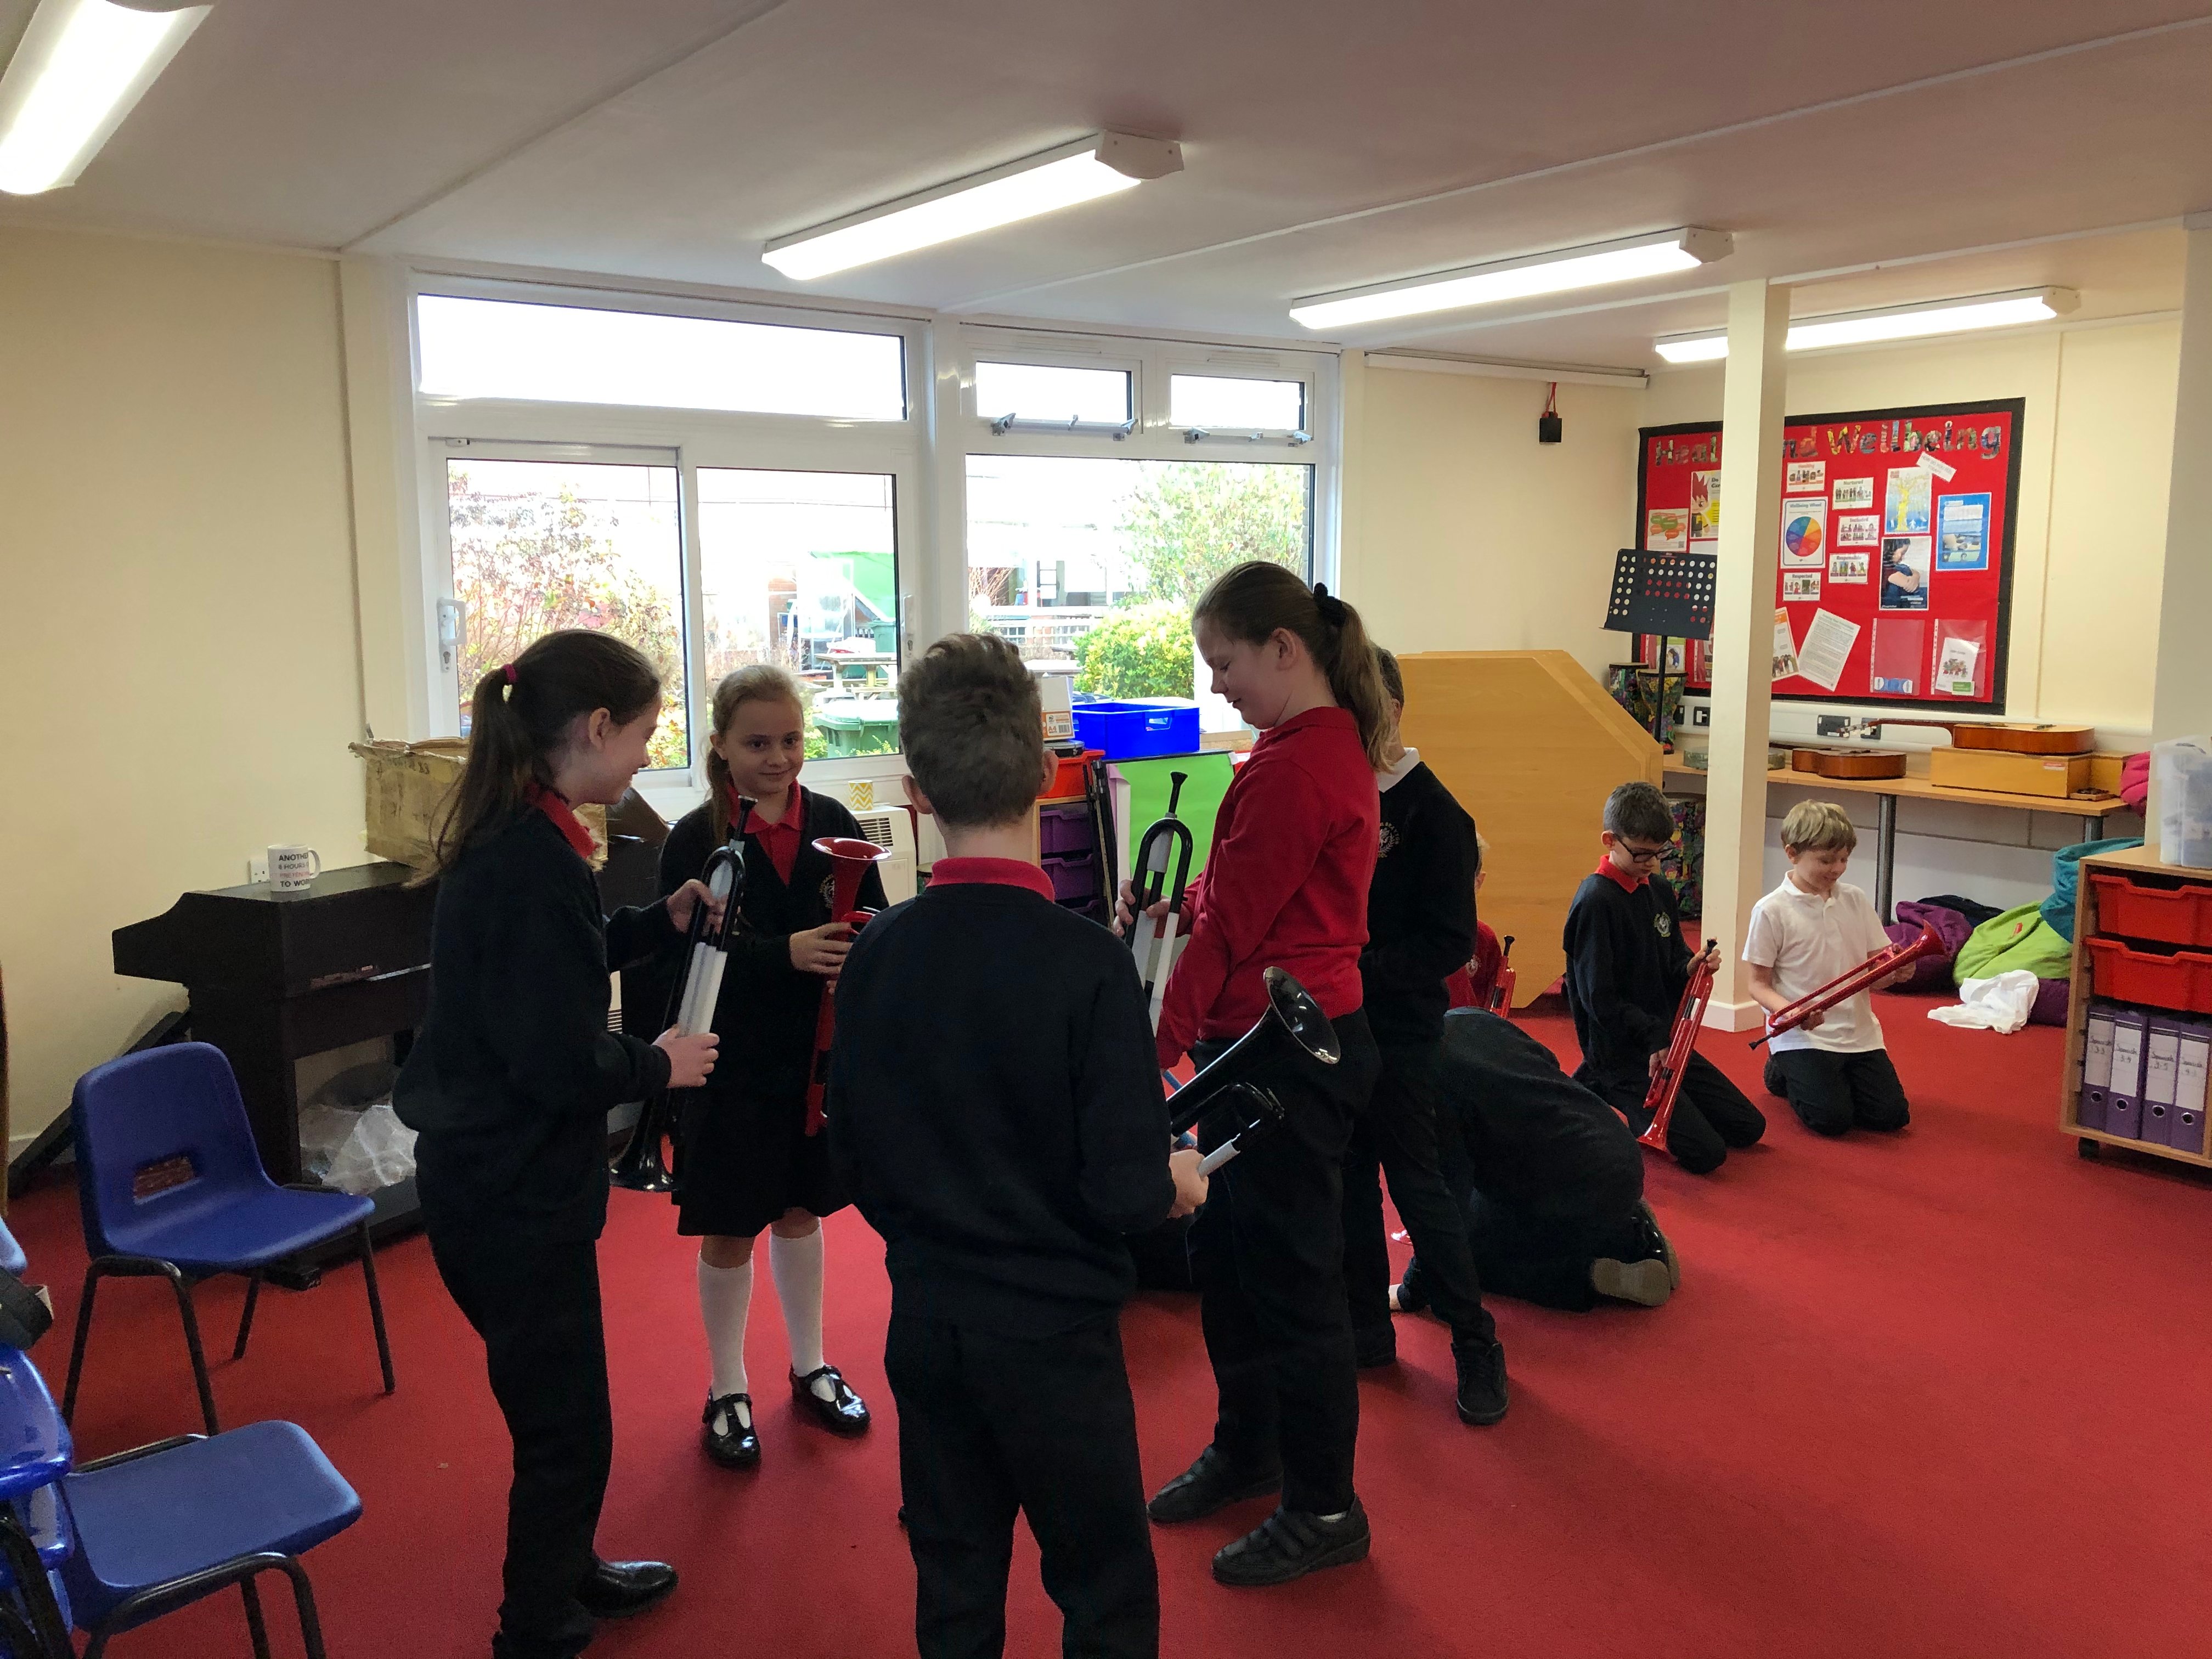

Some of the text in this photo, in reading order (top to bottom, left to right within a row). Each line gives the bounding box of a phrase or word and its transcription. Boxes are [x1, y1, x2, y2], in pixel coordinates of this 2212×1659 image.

[1656, 420, 2002, 466] Heal nd Wellbeing
